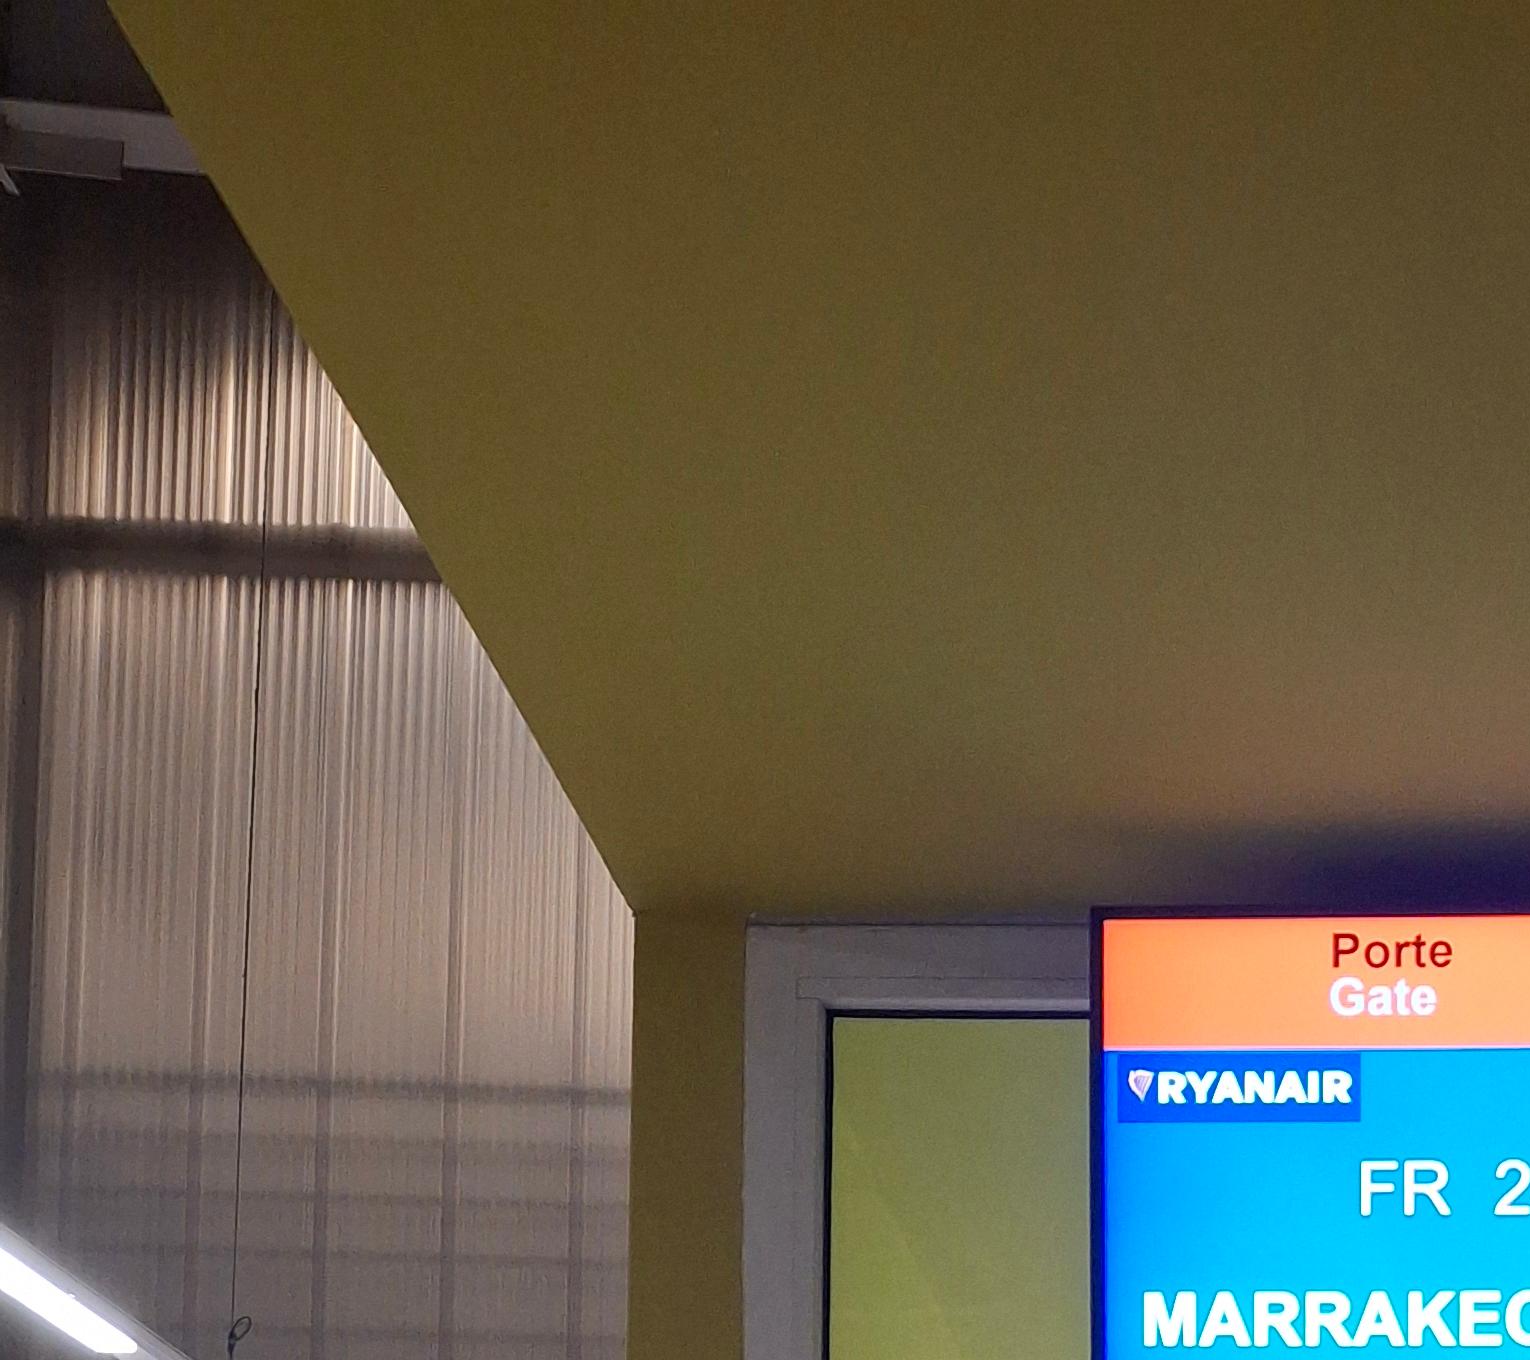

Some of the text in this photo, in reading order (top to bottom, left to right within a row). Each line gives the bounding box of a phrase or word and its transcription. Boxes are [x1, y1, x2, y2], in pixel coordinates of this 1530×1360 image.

[1332, 933, 1453, 968] Porte
[1329, 976, 1438, 1017] Gate
[1157, 1070, 1353, 1104] RYANAIR
[1358, 1159, 1451, 1217] FR
